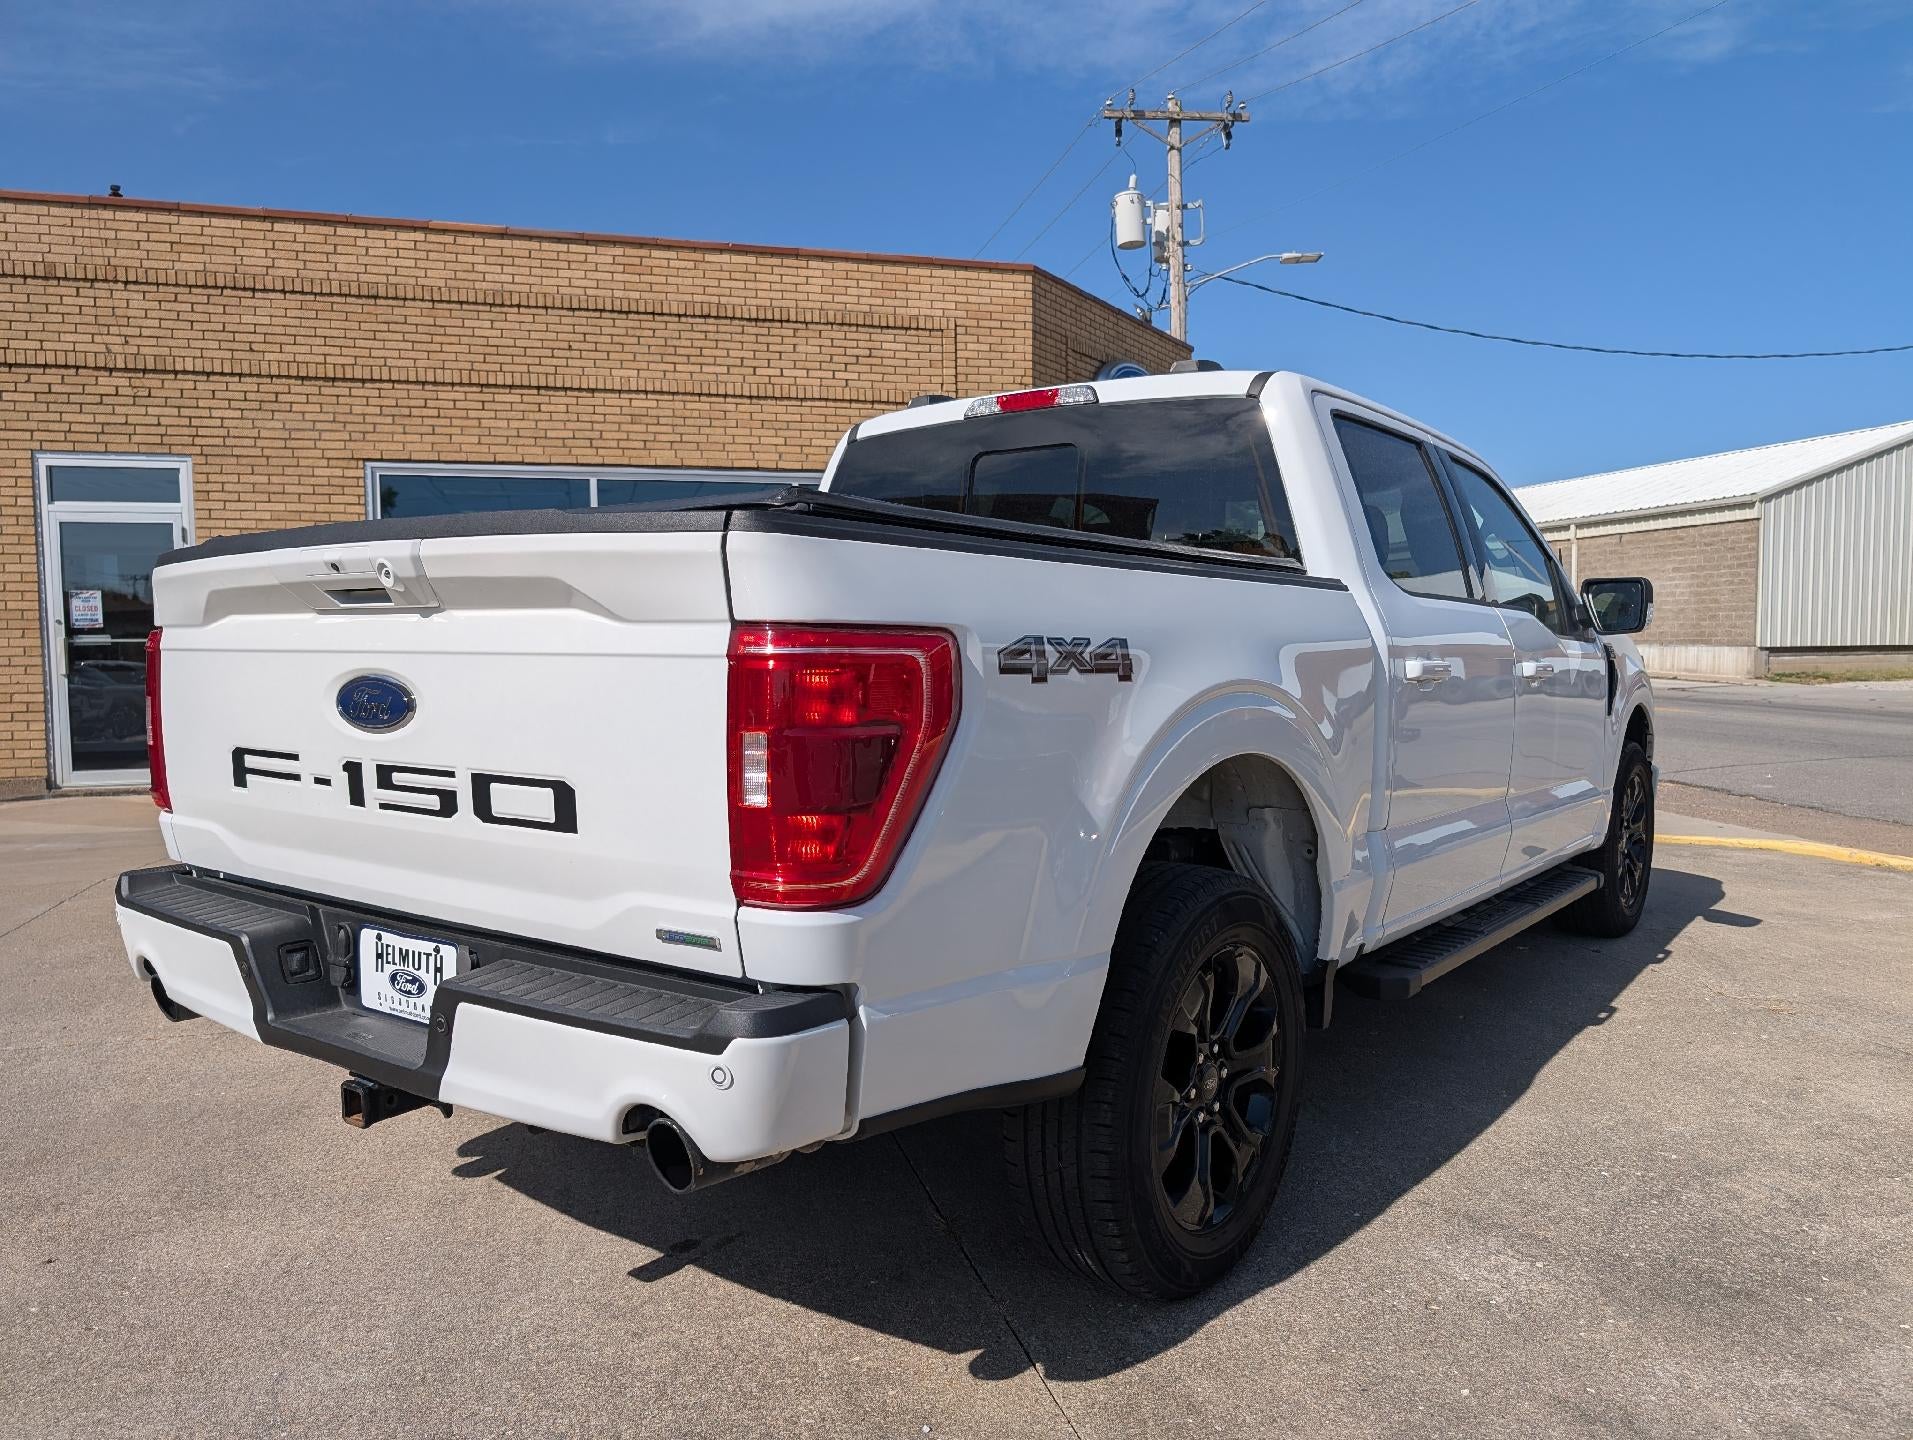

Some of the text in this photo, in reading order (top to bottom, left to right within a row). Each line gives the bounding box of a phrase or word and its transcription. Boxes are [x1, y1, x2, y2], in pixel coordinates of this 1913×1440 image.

[350, 686, 393, 722] Ford
[232, 747, 579, 835] F-150
[375, 941, 444, 986] HELMUTH
[395, 973, 419, 994] Ford
